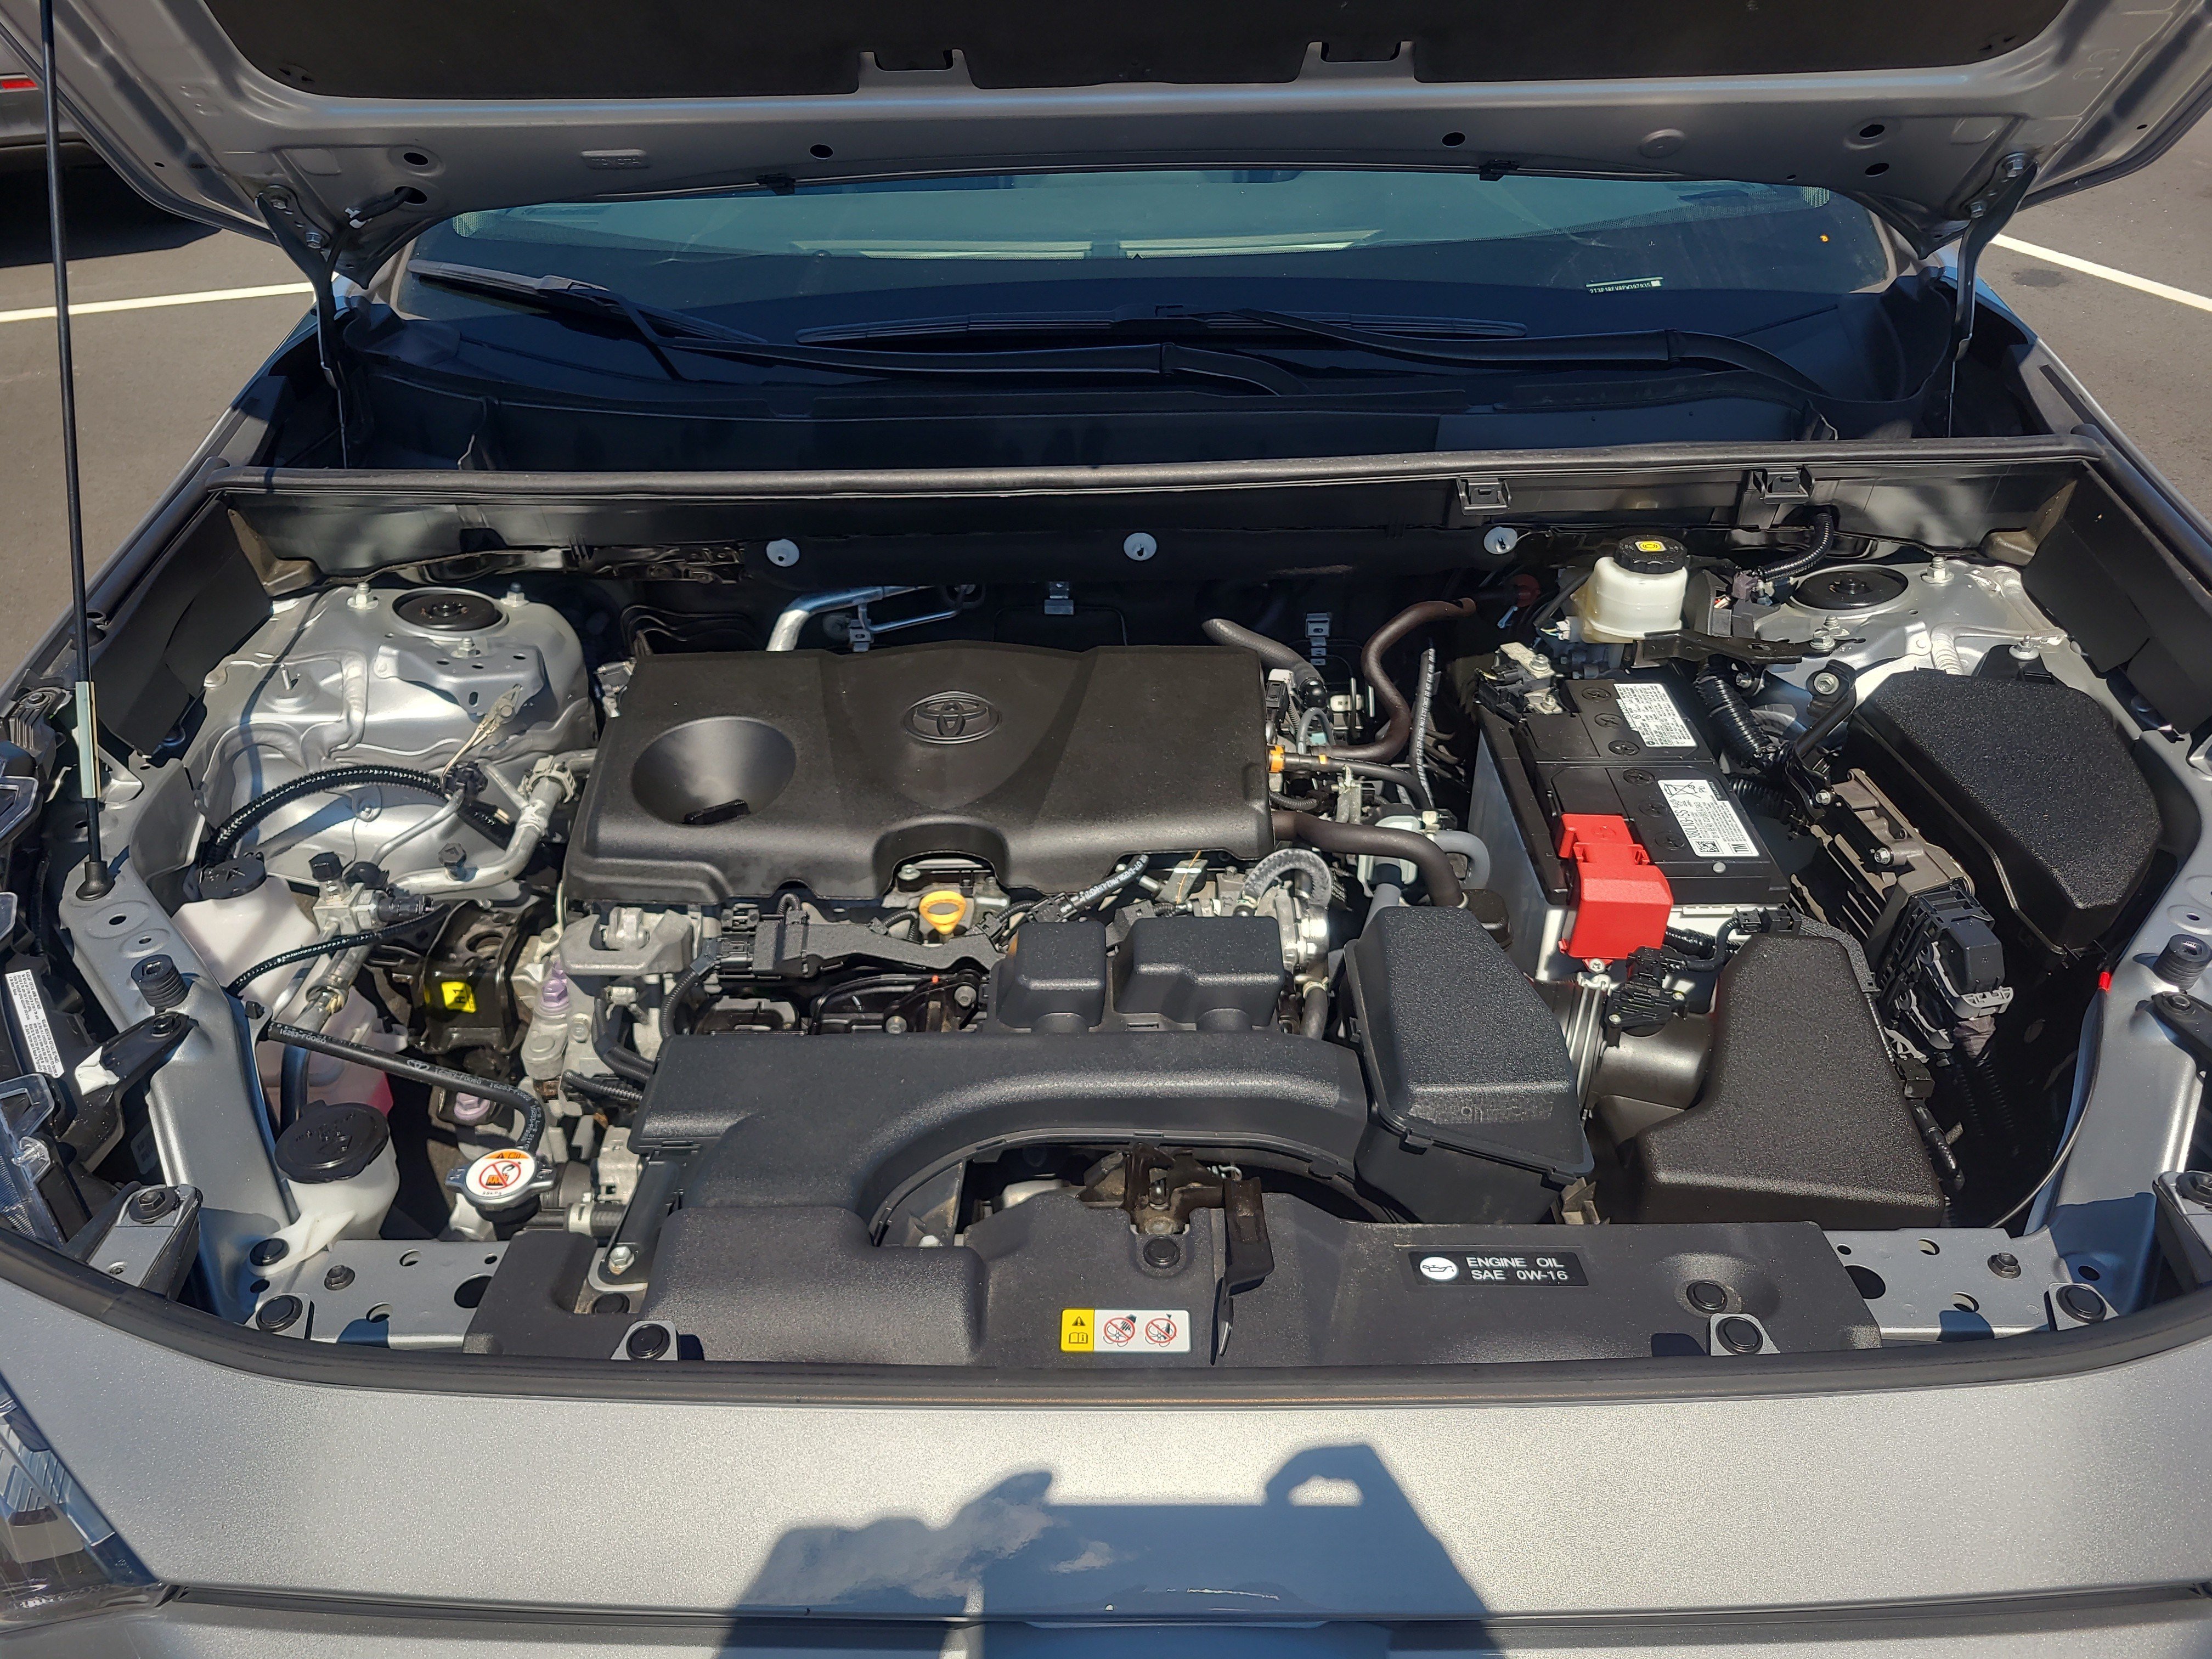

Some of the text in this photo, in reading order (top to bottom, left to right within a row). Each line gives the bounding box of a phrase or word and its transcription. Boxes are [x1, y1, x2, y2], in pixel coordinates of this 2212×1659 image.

[1674, 810, 1702, 838] 380LN3-ISS
[1734, 844, 1749, 853] TM
[452, 989, 466, 1003] A1
[1466, 1257, 1565, 1268] ENGINE OIL
[1470, 1269, 1568, 1281] SAE 0W-16
